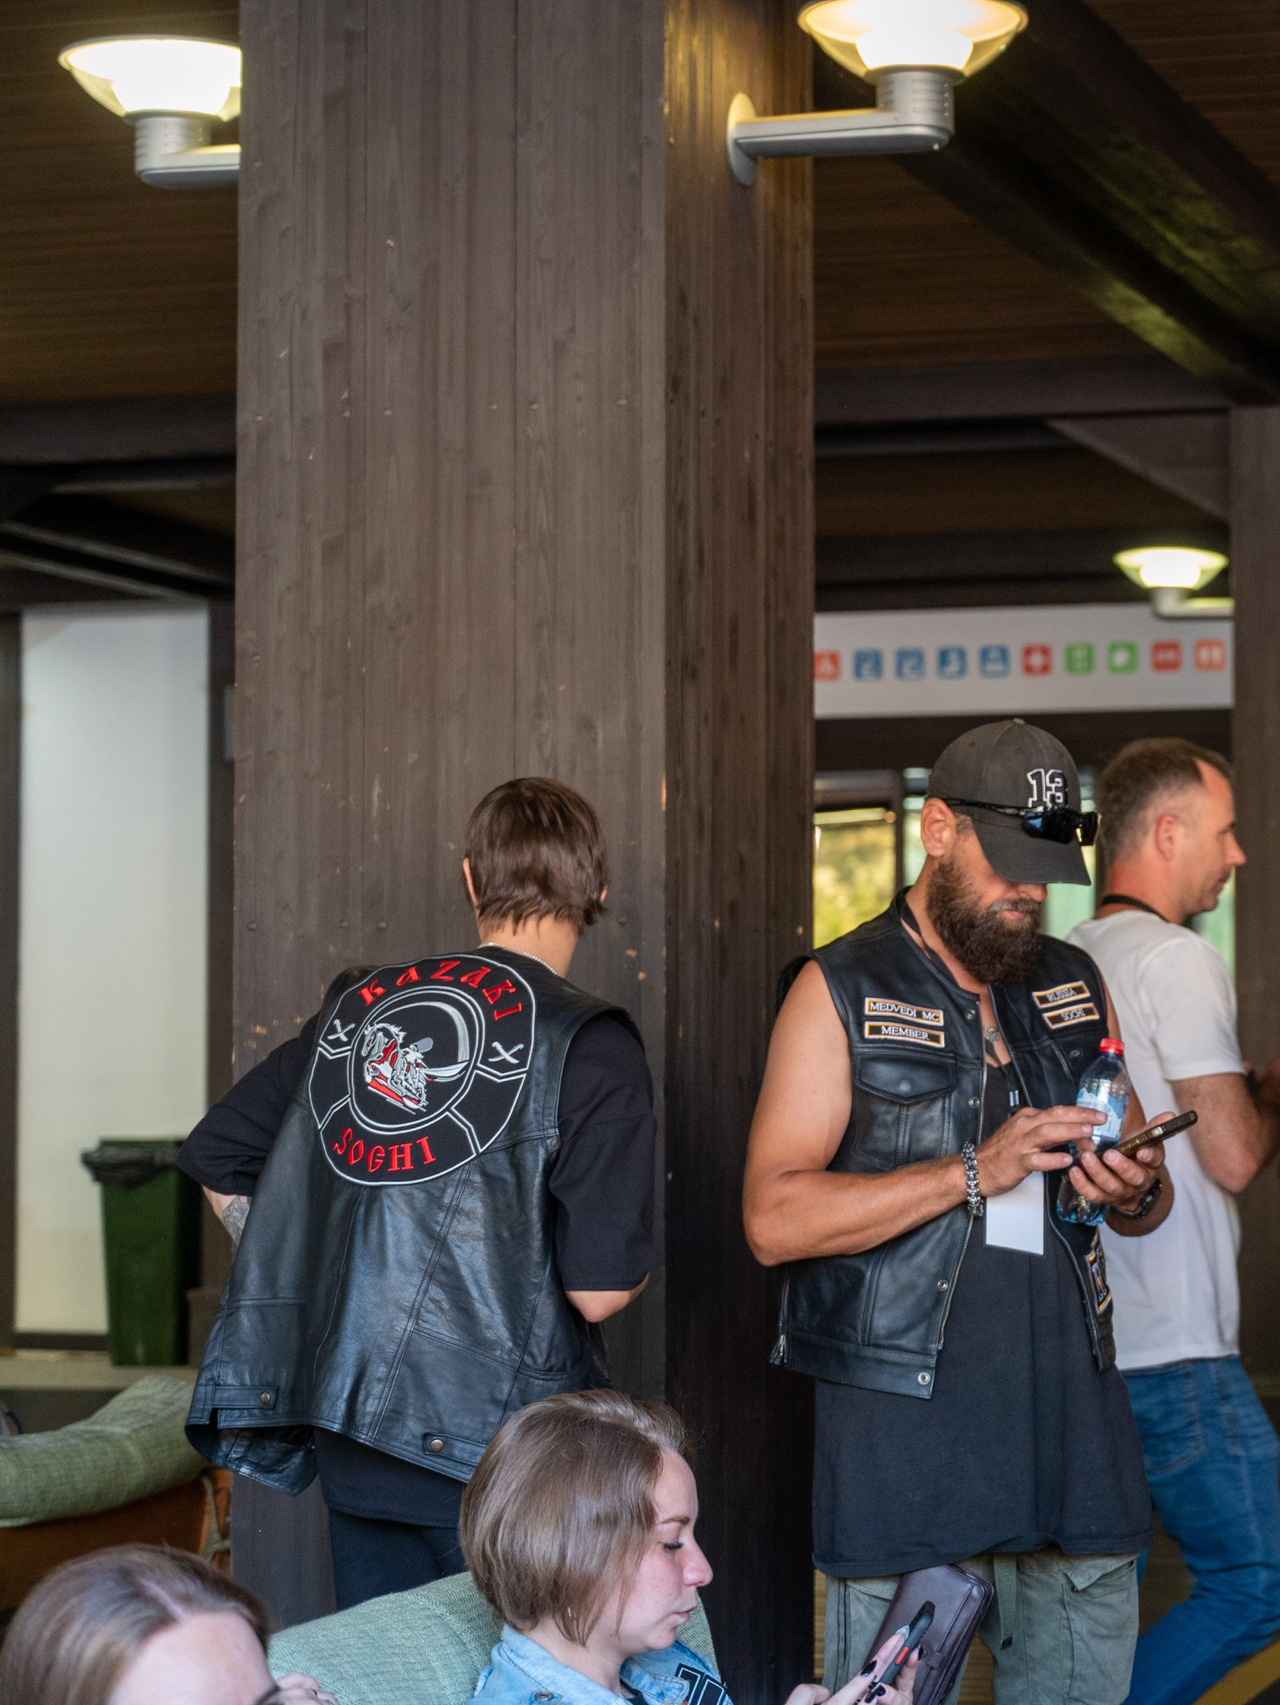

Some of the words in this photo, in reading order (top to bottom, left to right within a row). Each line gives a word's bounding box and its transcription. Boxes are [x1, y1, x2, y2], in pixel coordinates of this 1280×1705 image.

[1046, 987, 1077, 1001] RUSSIA
[870, 1001, 917, 1018] MEDVEDI
[922, 1011, 940, 1021] MC
[1061, 1008, 1086, 1021] SOCHI
[881, 1025, 930, 1040] MEMBER
